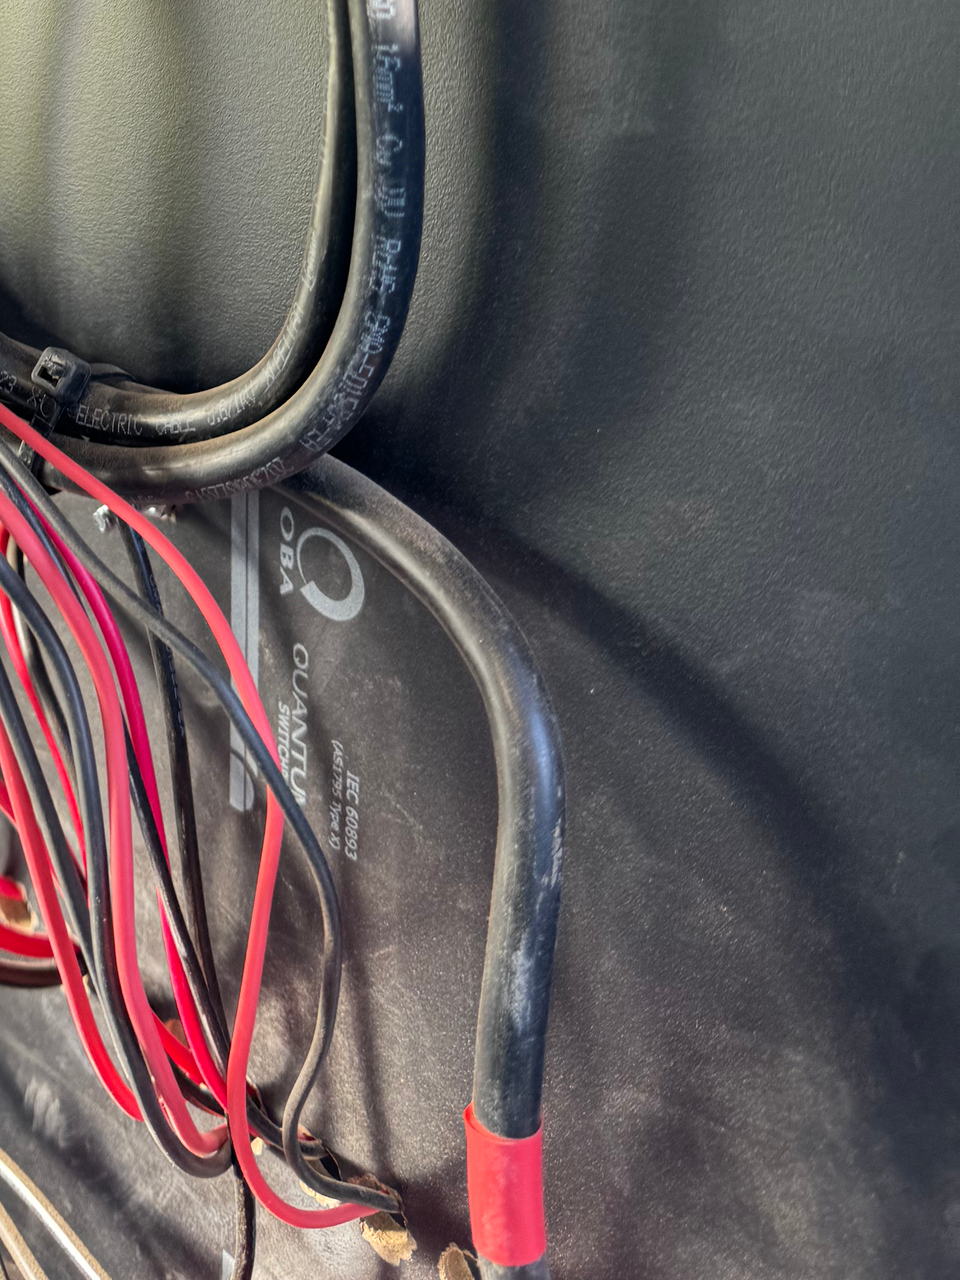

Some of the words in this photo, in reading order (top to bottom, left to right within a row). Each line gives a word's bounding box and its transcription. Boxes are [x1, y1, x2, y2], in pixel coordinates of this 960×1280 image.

[76, 404, 143, 436] ELECTRIC
[155, 410, 196, 436] CABLE
[331, 739, 344, 801] (AS1795
[346, 770, 360, 805] IEC
[328, 802, 342, 832] Type
[328, 833, 341, 850] X)
[344, 806, 359, 862] 60893
